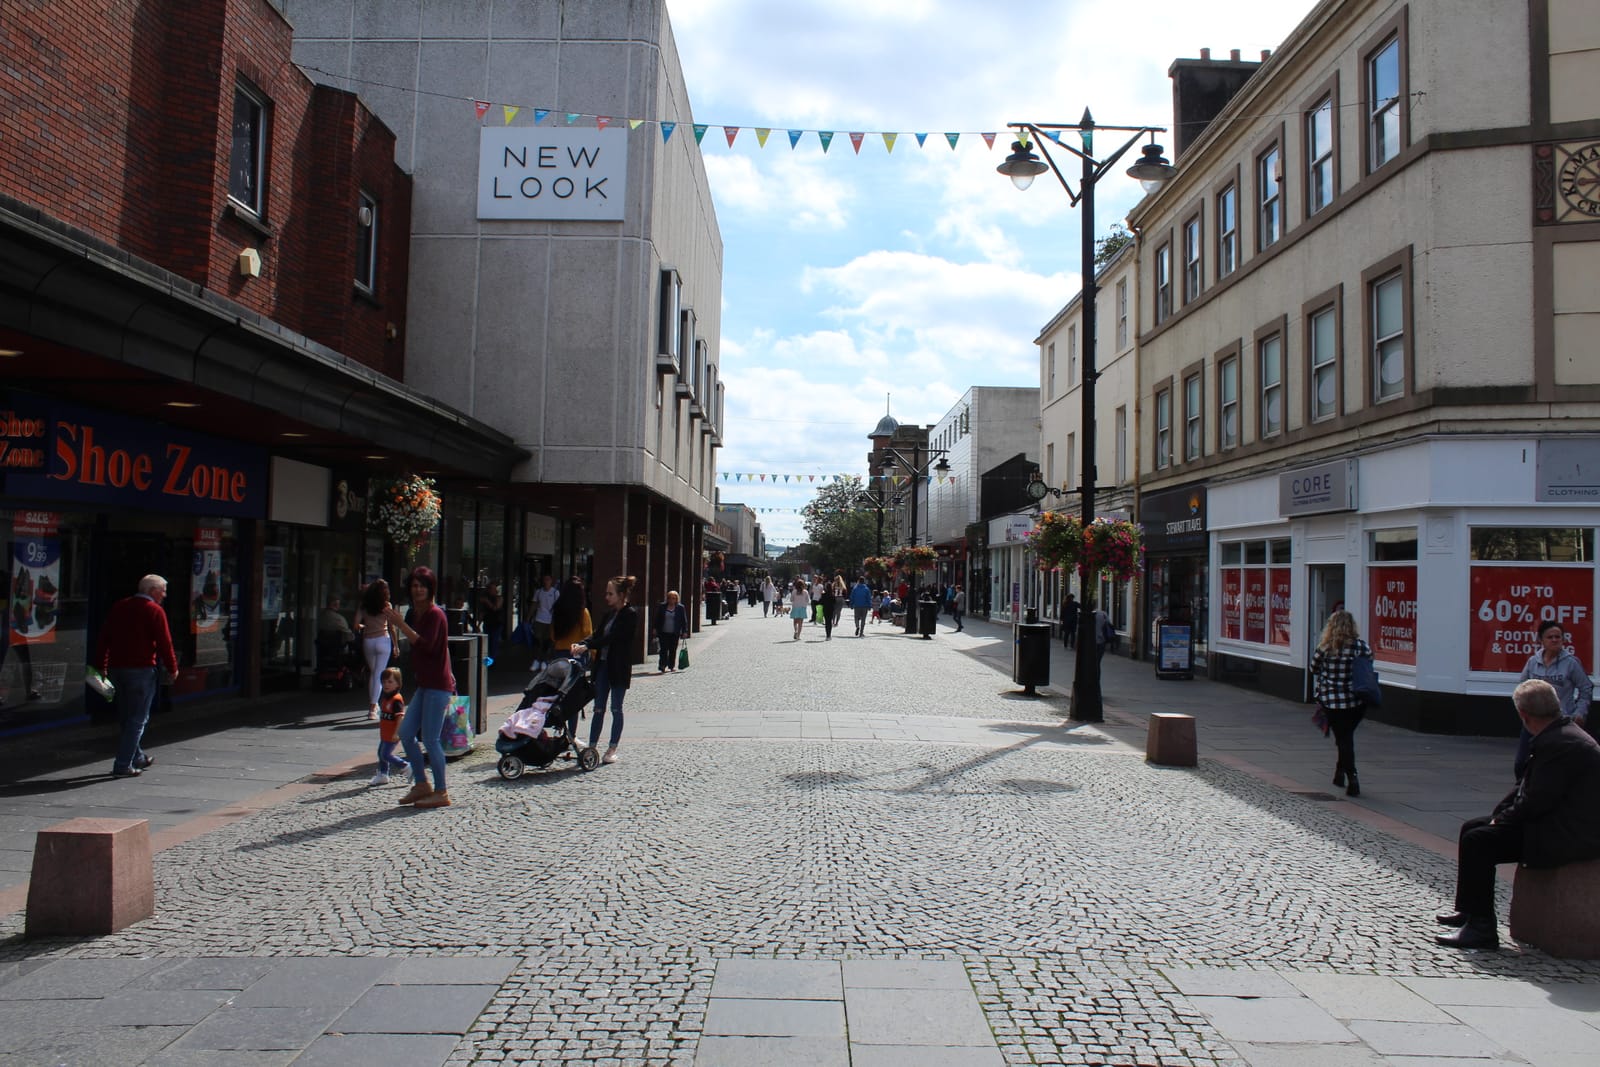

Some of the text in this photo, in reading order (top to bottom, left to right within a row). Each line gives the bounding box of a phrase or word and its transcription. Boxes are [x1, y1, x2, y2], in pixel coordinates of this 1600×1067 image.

[504, 146, 600, 168] NEW
[494, 176, 608, 200] LOOK
[0, 410, 45, 438] Shoe
[0, 440, 45, 468] Zone
[46, 420, 248, 503] Shoe Zone
[1293, 473, 1331, 495] CORE
[1548, 489, 1600, 497] CLOTHING
[25, 511, 49, 524] SALE
[1166, 517, 1203, 535] STEWART TRAVEL
[1387, 581, 1405, 592] UP TO
[1511, 585, 1553, 598] UP TO
[1376, 595, 1417, 619] 60% OFF
[1478, 599, 1587, 624] 60% OFF
[1381, 626, 1413, 639] FOOTWEAR
[1495, 630, 1573, 643] FOOTWR
[1385, 639, 1413, 652] CLOTHING
[1491, 642, 1502, 654] &
